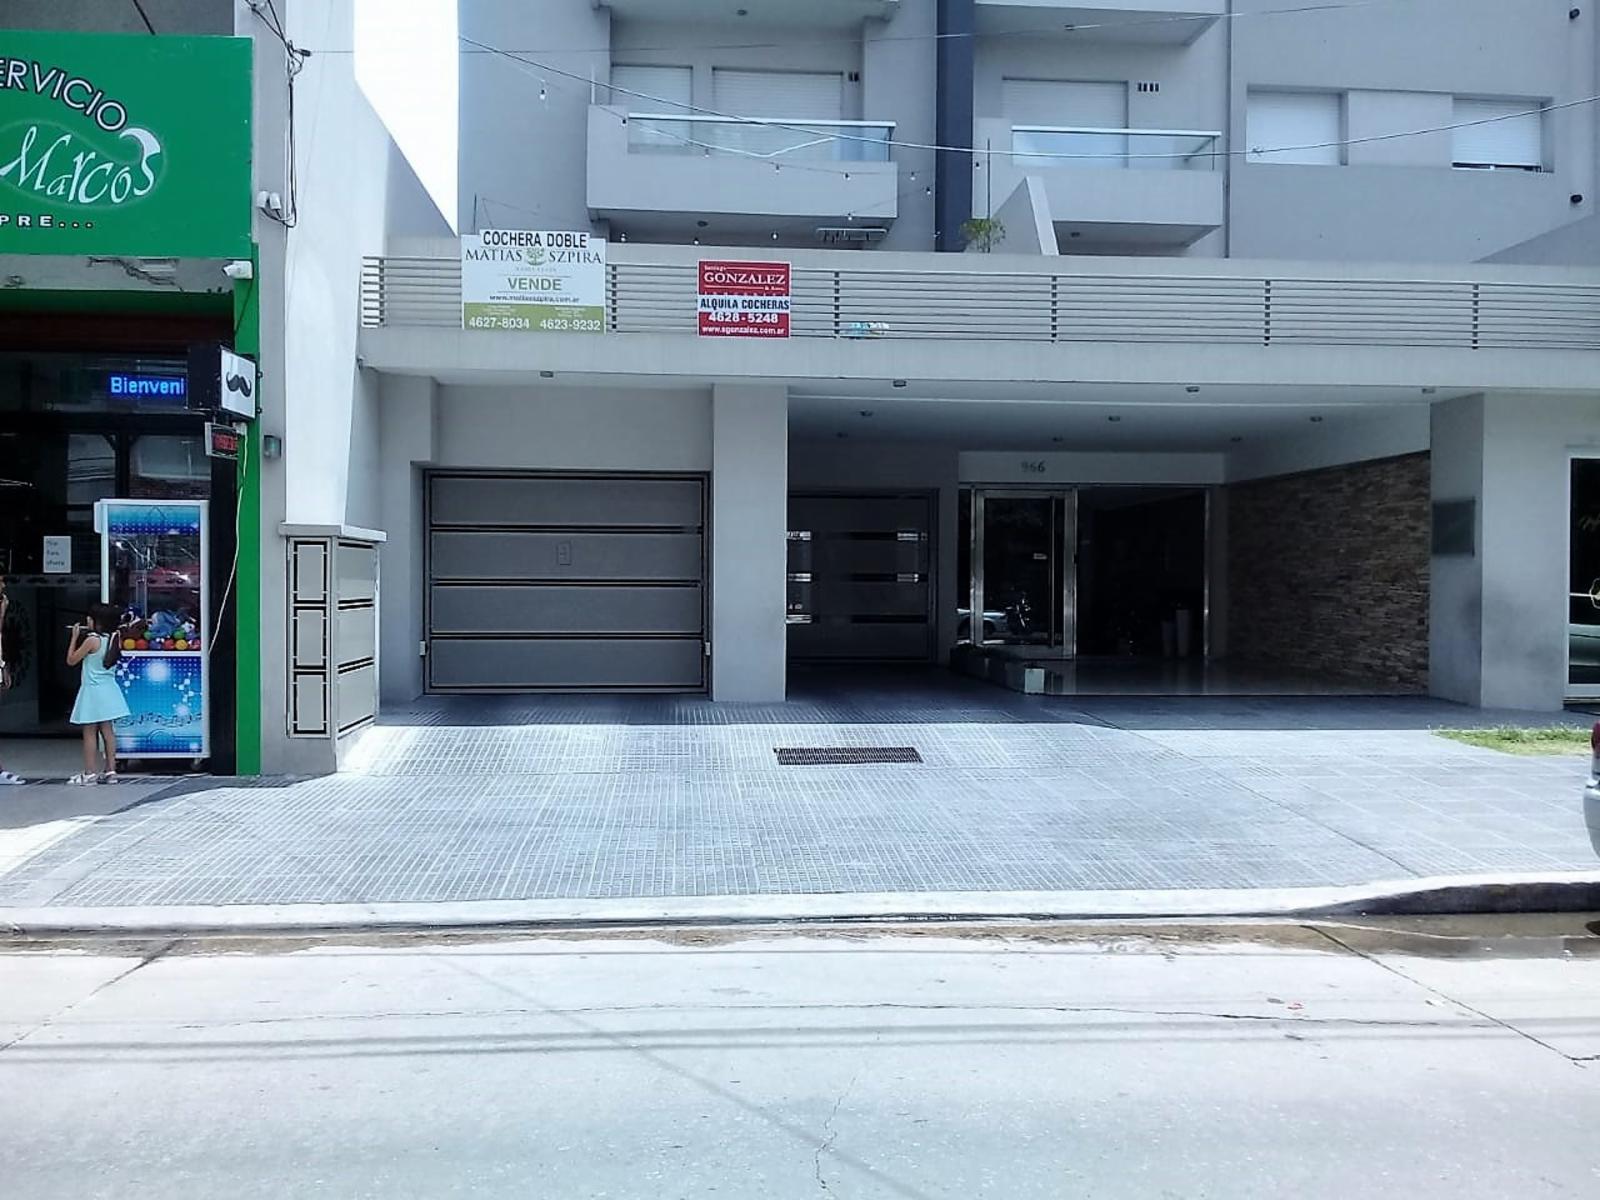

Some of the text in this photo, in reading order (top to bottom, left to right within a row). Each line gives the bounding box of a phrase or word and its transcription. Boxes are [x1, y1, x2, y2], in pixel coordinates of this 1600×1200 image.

[0, 126, 160, 203] Marcos
[483, 231, 587, 248] COCHERA DOBLE
[549, 250, 602, 264] SZPIRA
[508, 277, 562, 291] VENDE
[704, 272, 786, 285] GONZALEZ
[700, 298, 789, 310] ALQUILA COCHERAS
[111, 376, 185, 395] Bienveni
